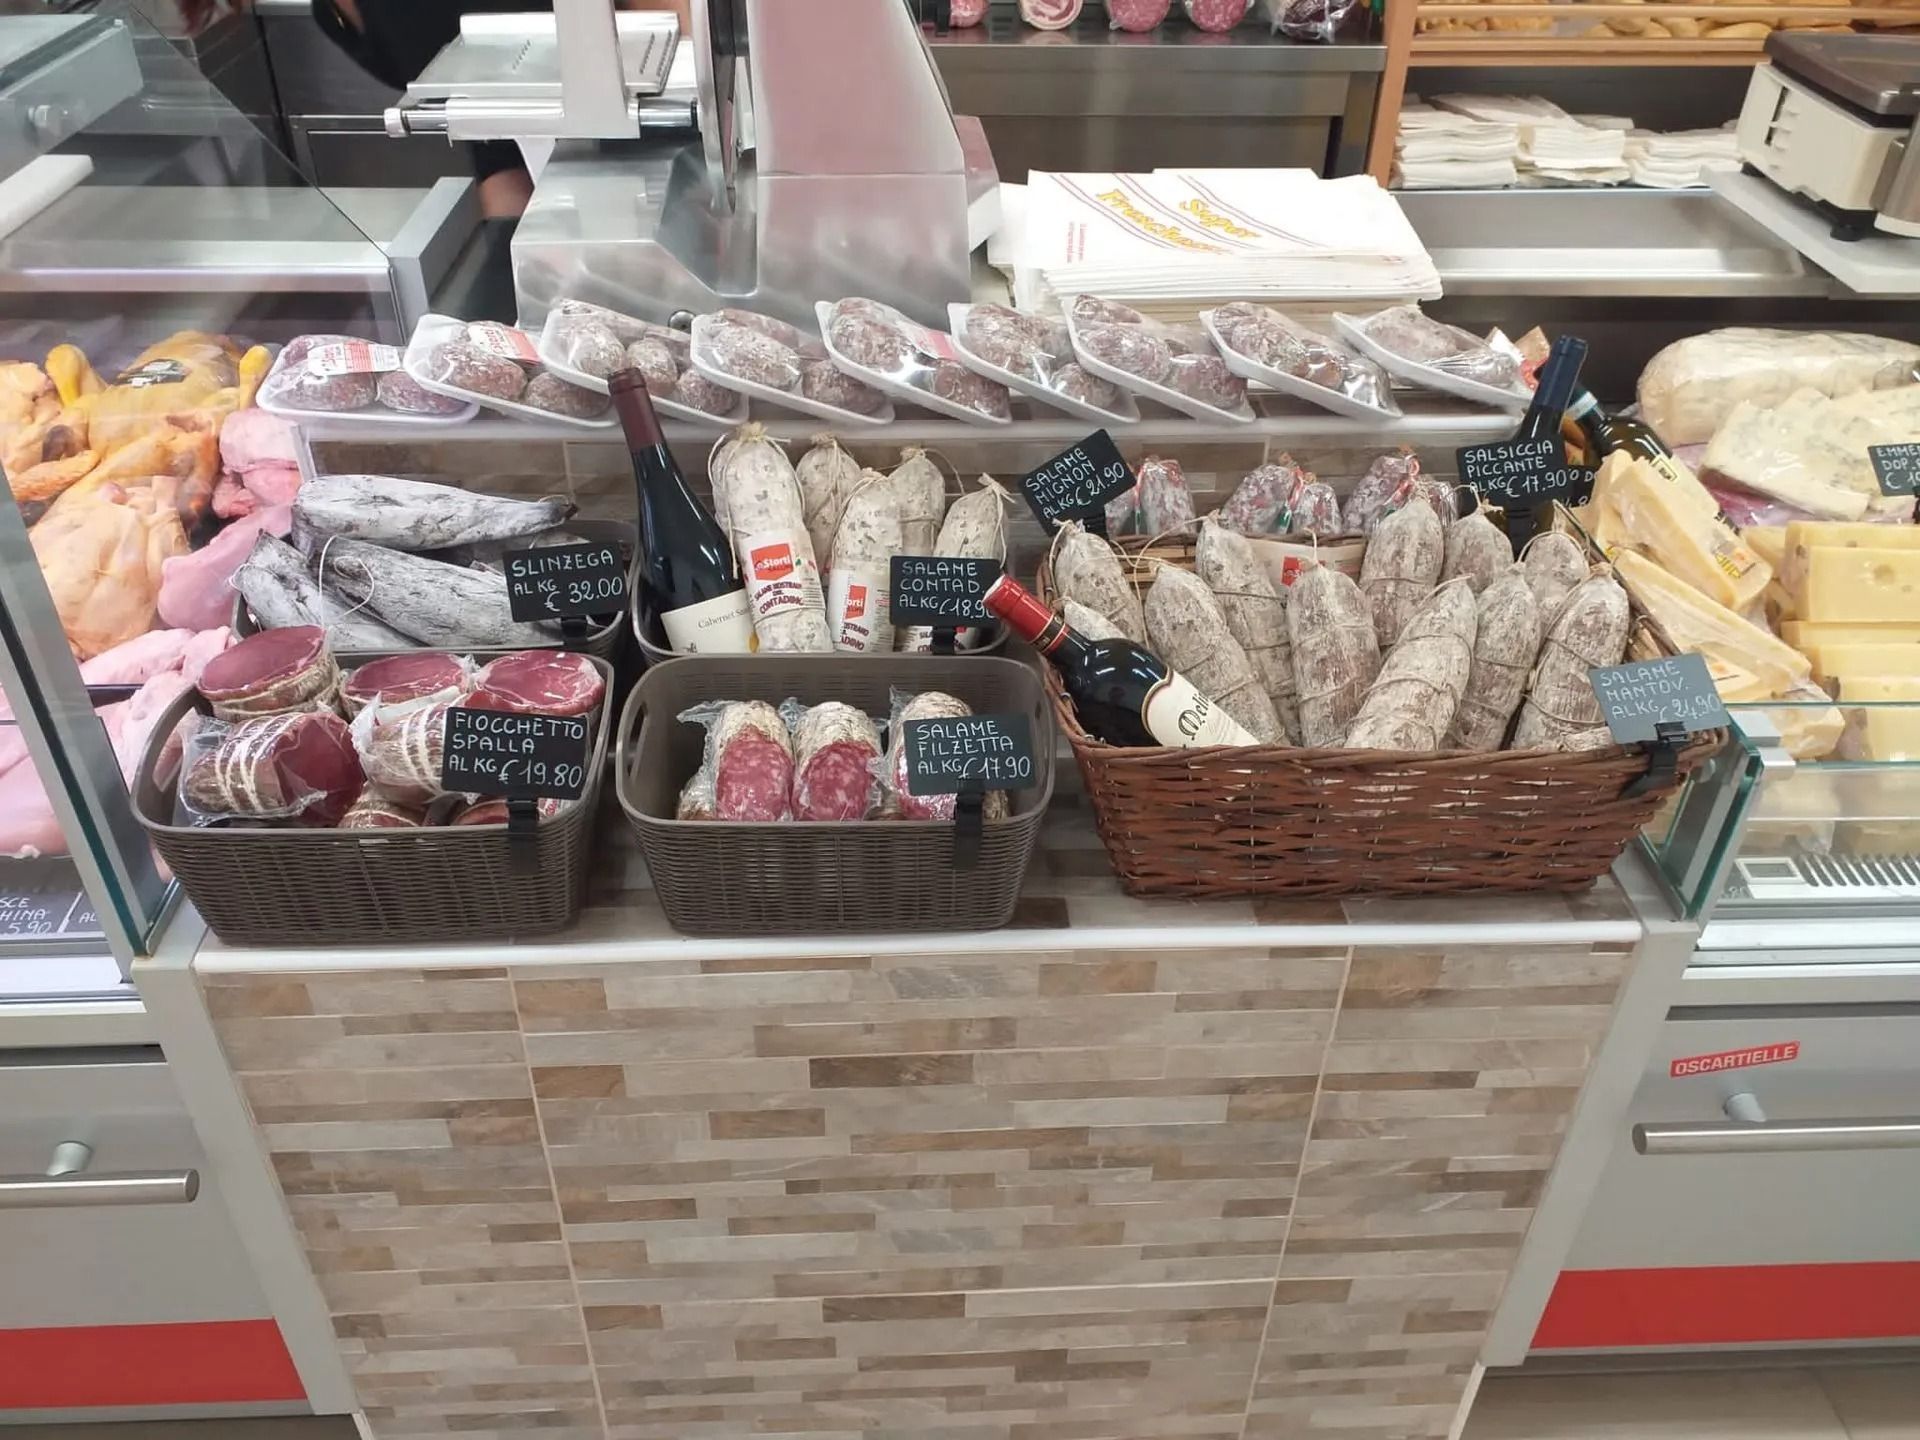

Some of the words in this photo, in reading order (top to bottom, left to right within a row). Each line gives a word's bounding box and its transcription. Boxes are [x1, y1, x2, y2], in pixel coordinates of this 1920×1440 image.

[1464, 440, 1553, 464] SALSICCIA
[1025, 447, 1087, 492] SALAME
[1467, 456, 1547, 478] PICCANTE
[1035, 460, 1095, 505] MIGNON
[1522, 469, 1567, 493] 17.90
[511, 549, 614, 577] SLINZEGA
[901, 561, 978, 577] SALAME
[514, 582, 533, 597] AL
[537, 578, 558, 593] KG
[568, 576, 623, 603] 32.00
[900, 578, 985, 593] CONTAD.
[1600, 661, 1681, 687] SALAME
[1606, 677, 1689, 701] MANTOV.
[455, 711, 584, 740] FIOCCHETTO
[916, 720, 998, 740] SALAME
[452, 733, 535, 754] SPALLA
[917, 736, 1014, 758] FILZETTA
[449, 754, 469, 772] AL
[473, 757, 497, 773] KG
[518, 759, 583, 788] 19.80
[977, 756, 1031, 780] 17.90
[0, 909, 47, 921] HINA
[1675, 1045, 1794, 1075] OSCARTIELLE
